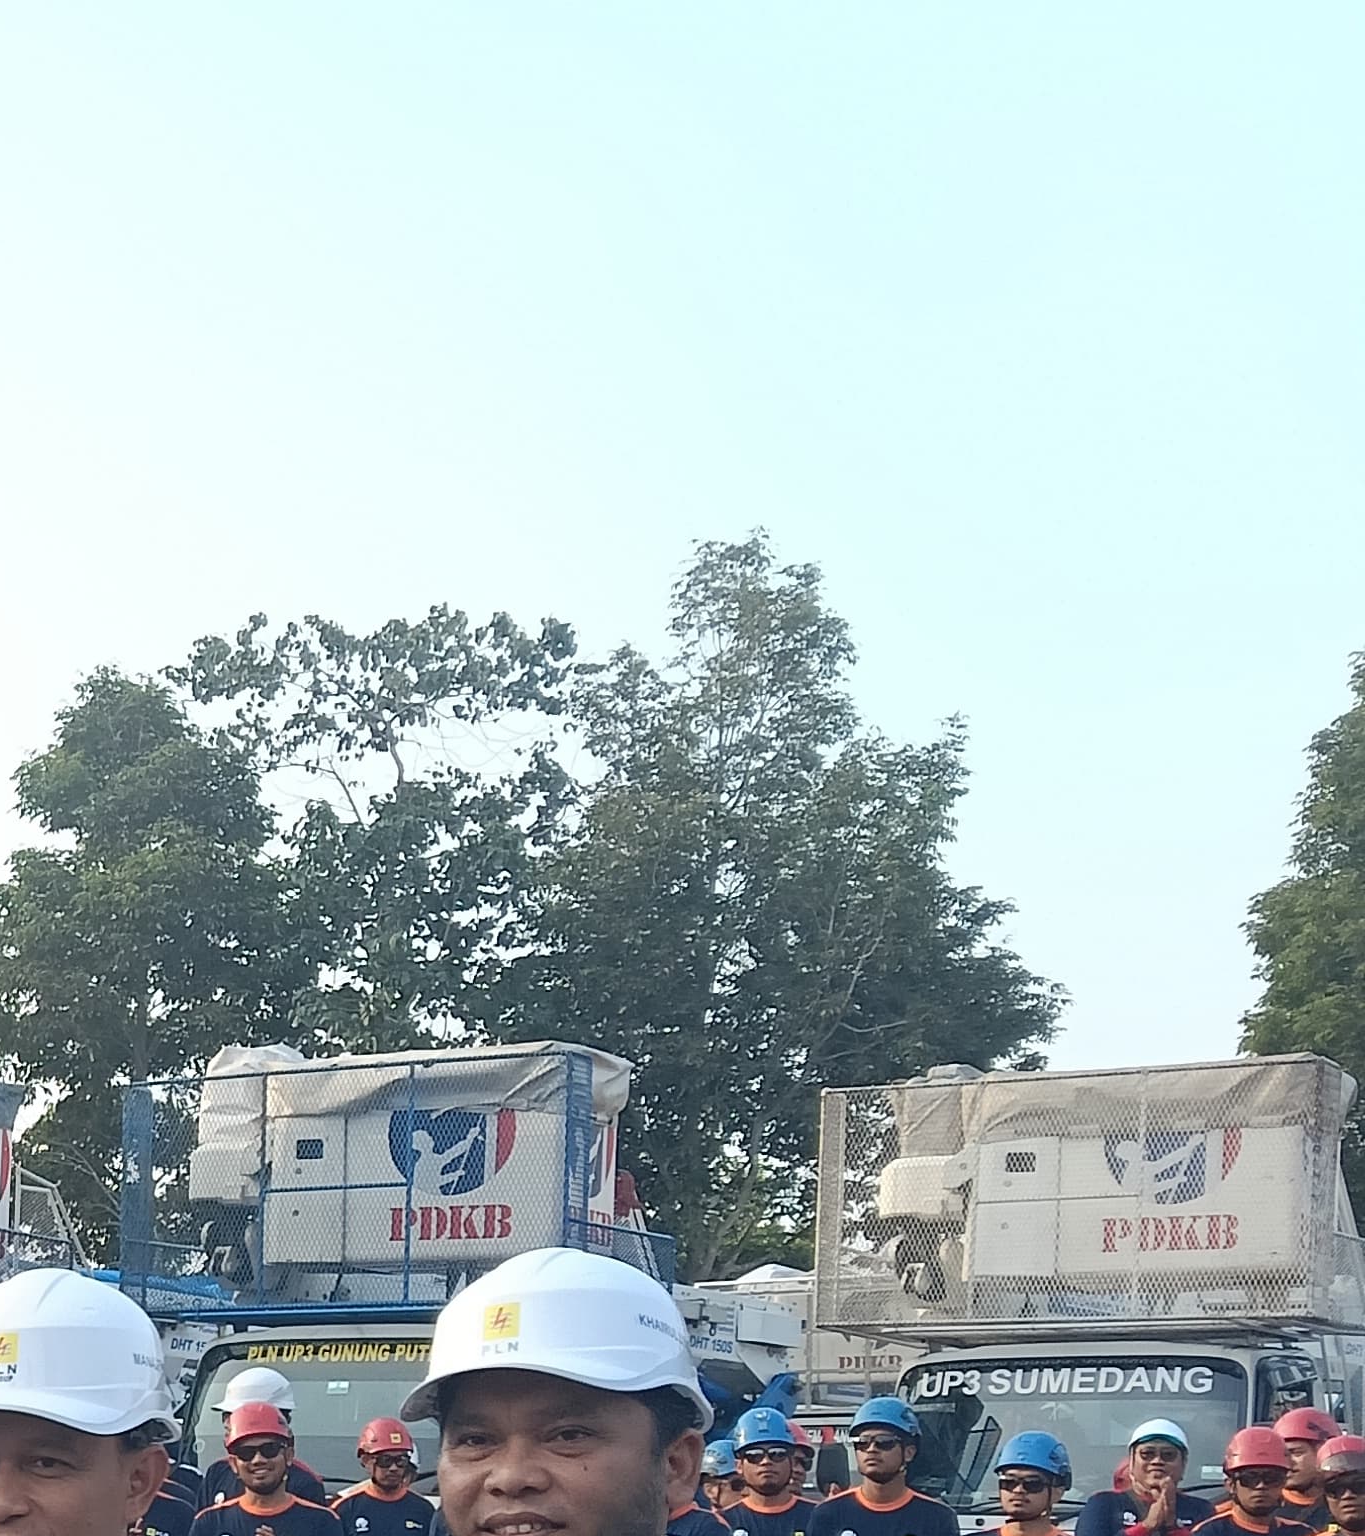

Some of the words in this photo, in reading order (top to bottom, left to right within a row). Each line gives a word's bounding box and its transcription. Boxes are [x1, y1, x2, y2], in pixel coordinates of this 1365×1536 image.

[389, 1203, 512, 1242] PDKB
[1101, 1214, 1240, 1253] PDKB
[170, 1337, 192, 1351] DHT
[482, 1341, 519, 1357] PLN
[689, 1335, 710, 1350] DHT
[248, 1345, 279, 1365] PLN
[282, 1344, 315, 1363] UP3
[317, 1343, 390, 1363] GUNUNG
[921, 1369, 981, 1398] UP3
[988, 1366, 1215, 1396] SUMEDANG
